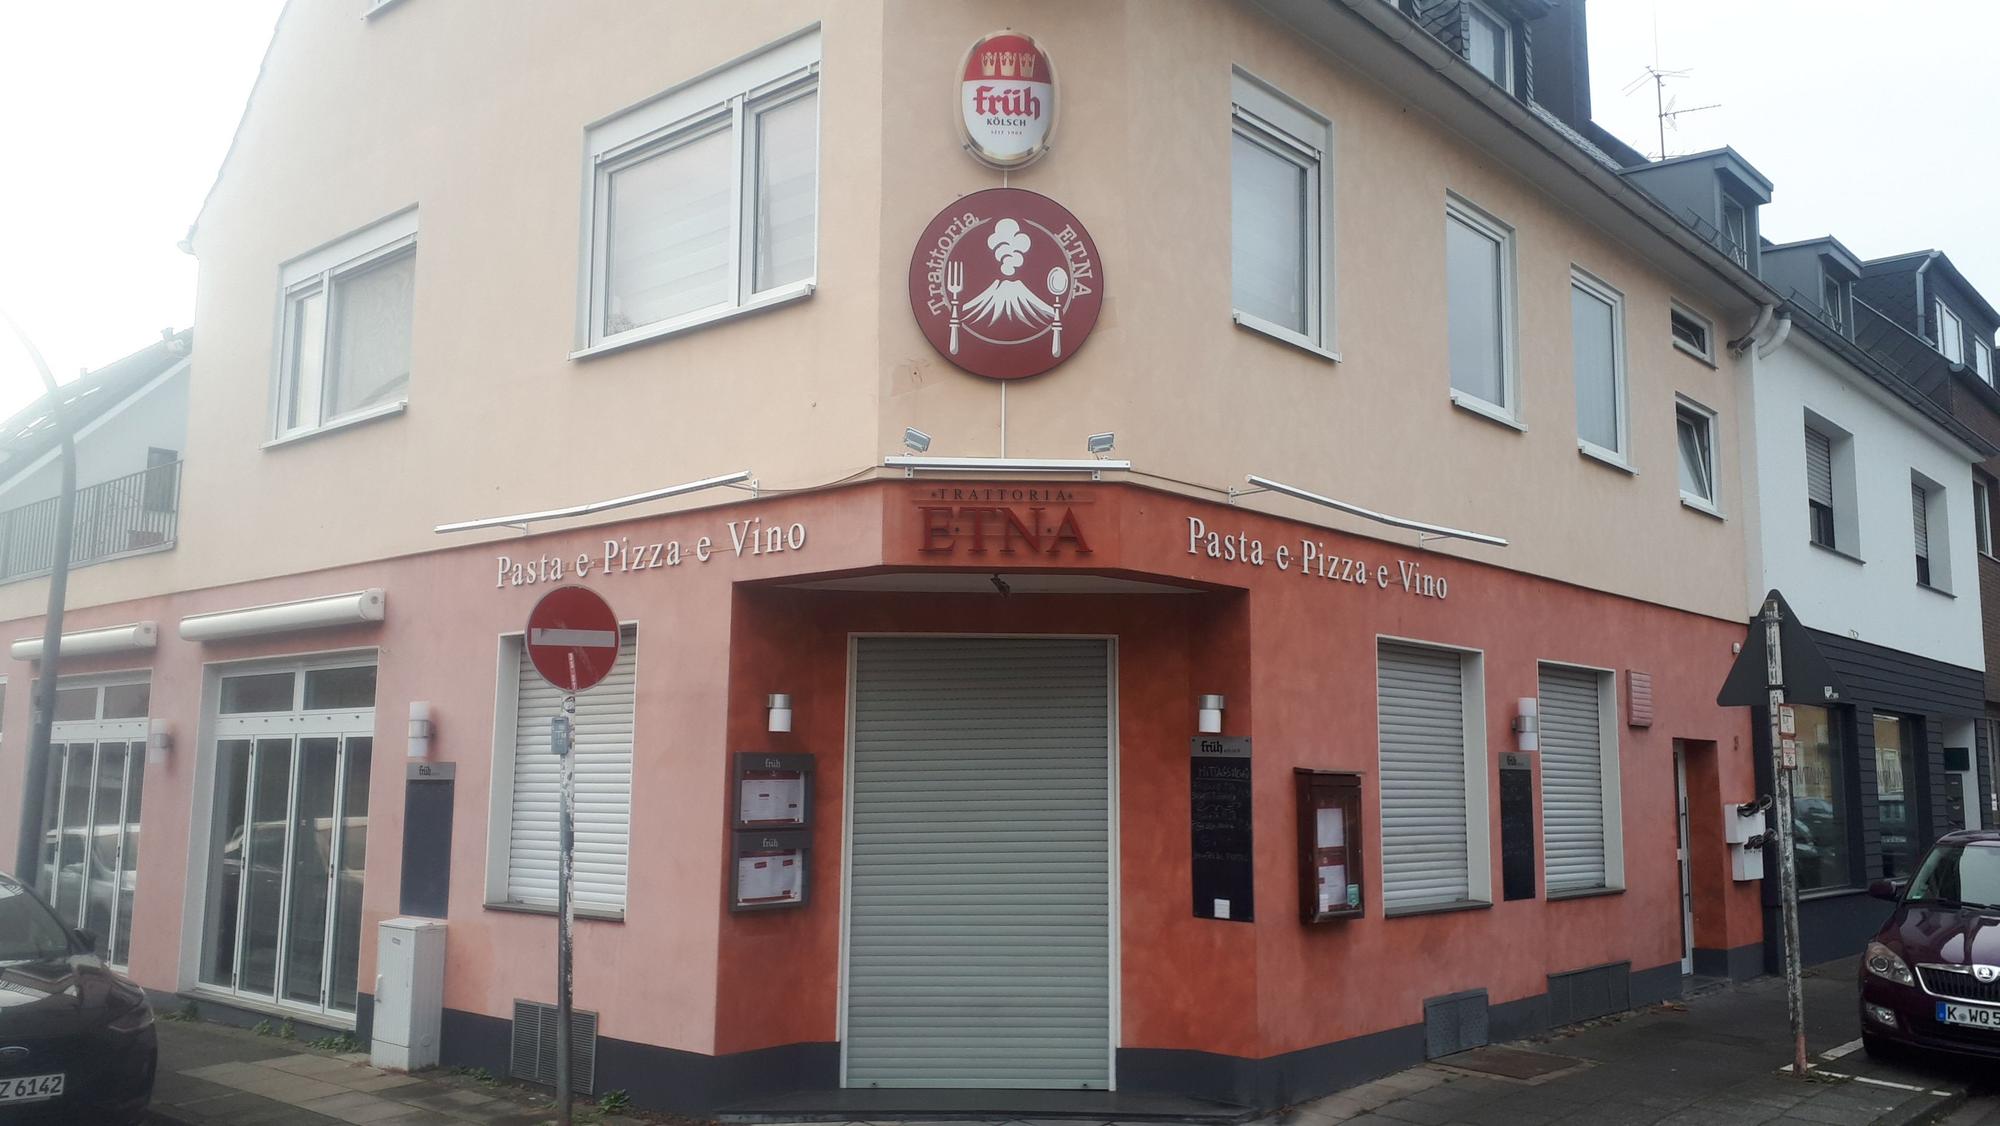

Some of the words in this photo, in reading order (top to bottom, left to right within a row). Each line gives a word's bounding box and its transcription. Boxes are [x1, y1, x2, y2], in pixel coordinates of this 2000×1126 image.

[973, 86, 1041, 120] früh
[986, 116, 1026, 127] KÖLSCH
[926, 212, 981, 316] Trattoria
[1054, 223, 1093, 299] ETNA
[938, 488, 1067, 501] TRATTORIA
[917, 506, 1094, 553] ETNA
[496, 551, 564, 588] Pasta
[575, 552, 591, 578] e
[603, 536, 682, 575] Pizza
[696, 534, 713, 562] e
[727, 516, 807, 558] Vino
[1186, 516, 1266, 566] Pasta
[1276, 544, 1290, 571] e
[1301, 539, 1369, 585] Pizza
[1377, 563, 1390, 589] e
[1398, 559, 1449, 600] Vino
[1201, 740, 1223, 754] früh
[764, 758, 781, 769] früh
[762, 838, 779, 848] früh
[1947, 1006, 1957, 1021] K
[1968, 1008, 1990, 1024] WQ
[0, 1081, 11, 1098] Z
[15, 1076, 62, 1097] 6142
